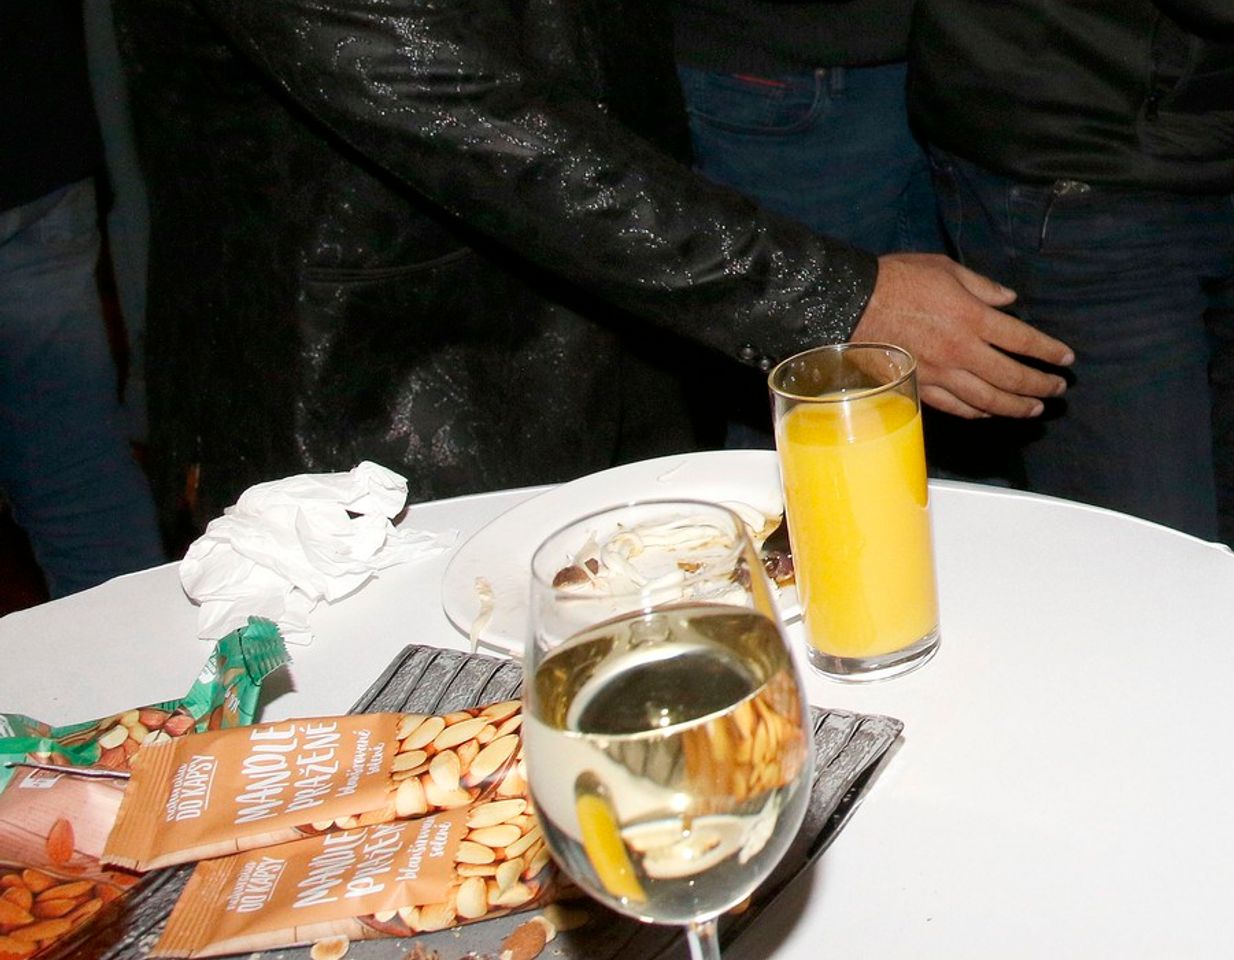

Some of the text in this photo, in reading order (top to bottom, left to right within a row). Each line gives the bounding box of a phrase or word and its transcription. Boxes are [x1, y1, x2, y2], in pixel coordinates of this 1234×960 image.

[176, 755, 216, 822] DO KAPSY
[234, 724, 298, 824] MANDLE
[285, 722, 341, 813] PRAŽENÉ
[237, 856, 286, 913] DO KAPSY
[292, 828, 368, 908] MANDLE
